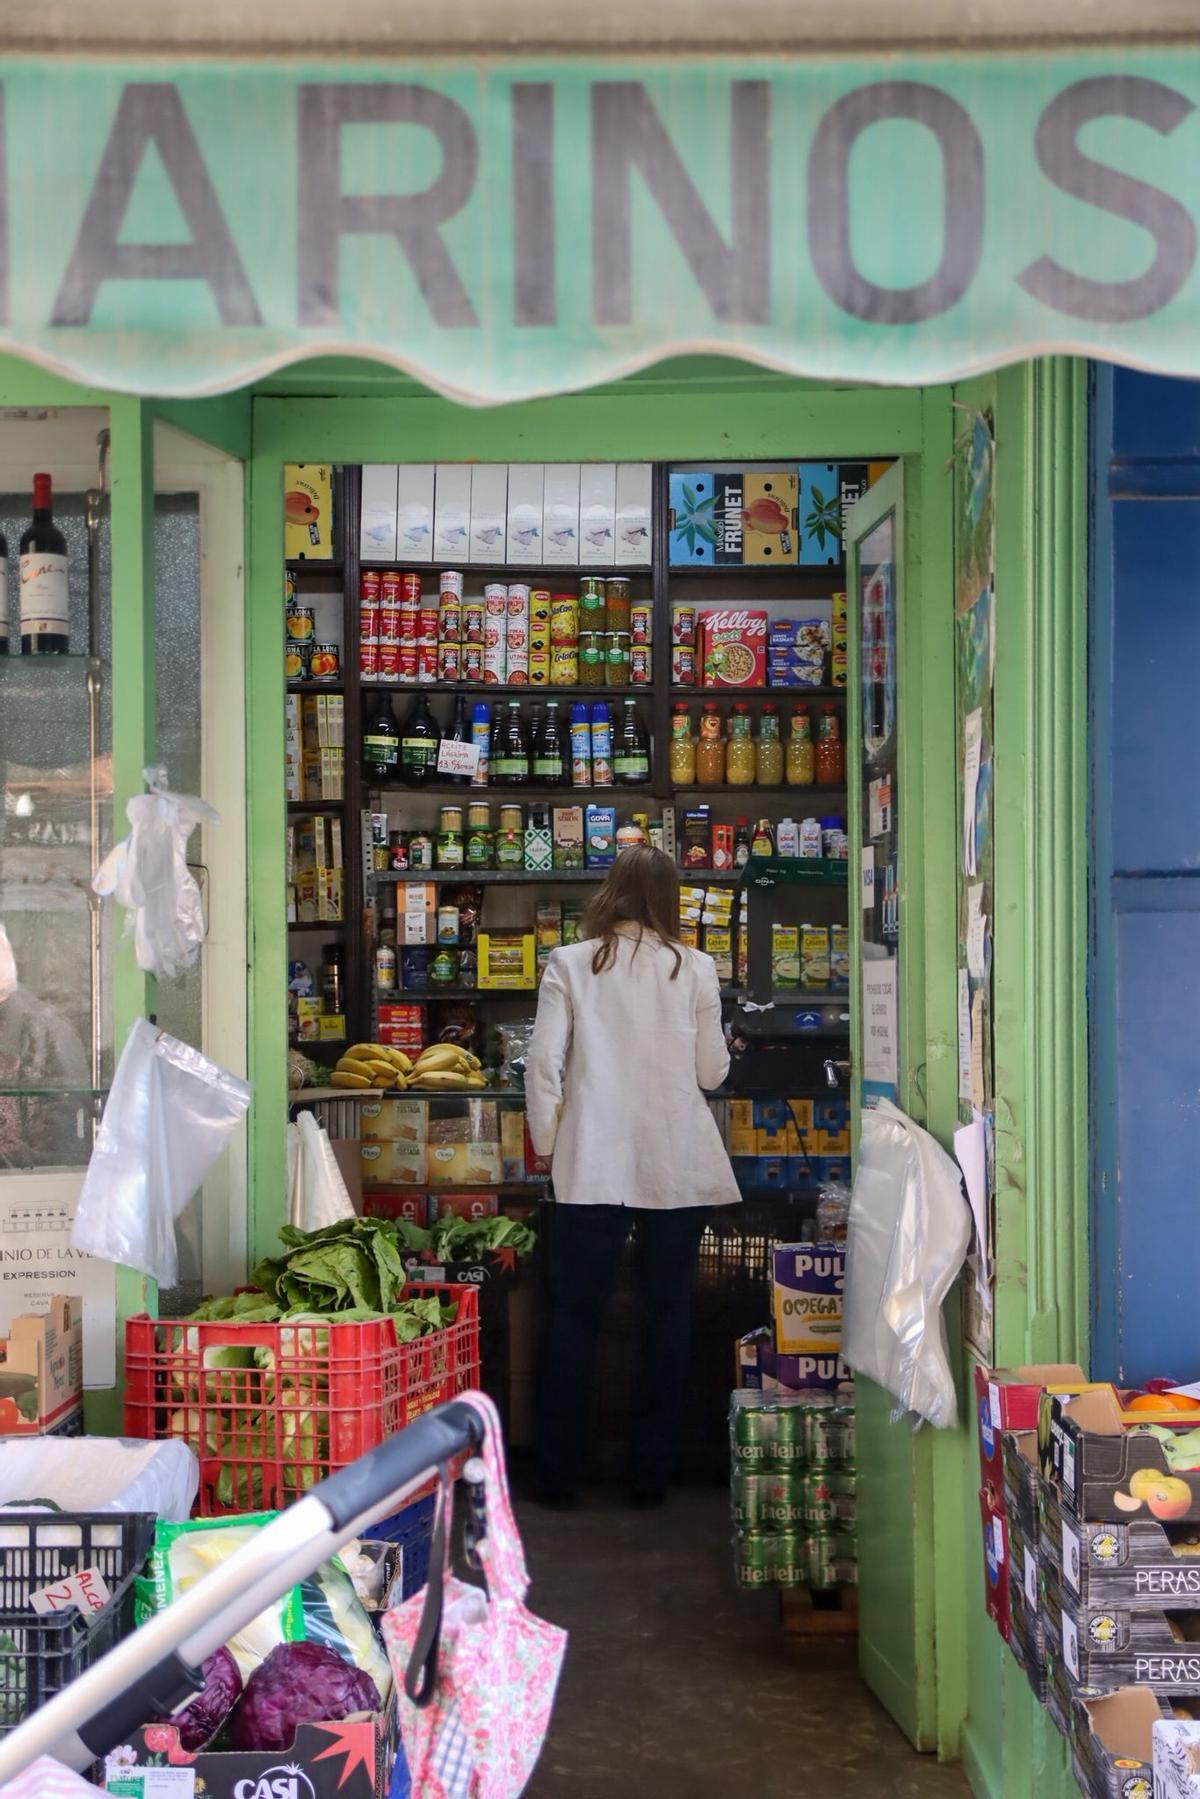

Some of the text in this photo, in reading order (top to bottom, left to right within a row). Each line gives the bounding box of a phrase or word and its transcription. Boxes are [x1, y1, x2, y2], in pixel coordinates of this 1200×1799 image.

[0, 74, 1199, 328] ARINOS
[724, 485, 742, 553] FRUNET
[590, 814, 610, 822] GOYA
[36, 1248, 53, 1260] DE
[57, 1248, 73, 1259] LA
[3, 1269, 76, 1281] EXPRESSION
[456, 1270, 485, 1283] CASI
[1134, 1570, 1200, 1594] PERAS
[1134, 1658, 1200, 1683] PERAS
[233, 1778, 298, 1799] CASI
